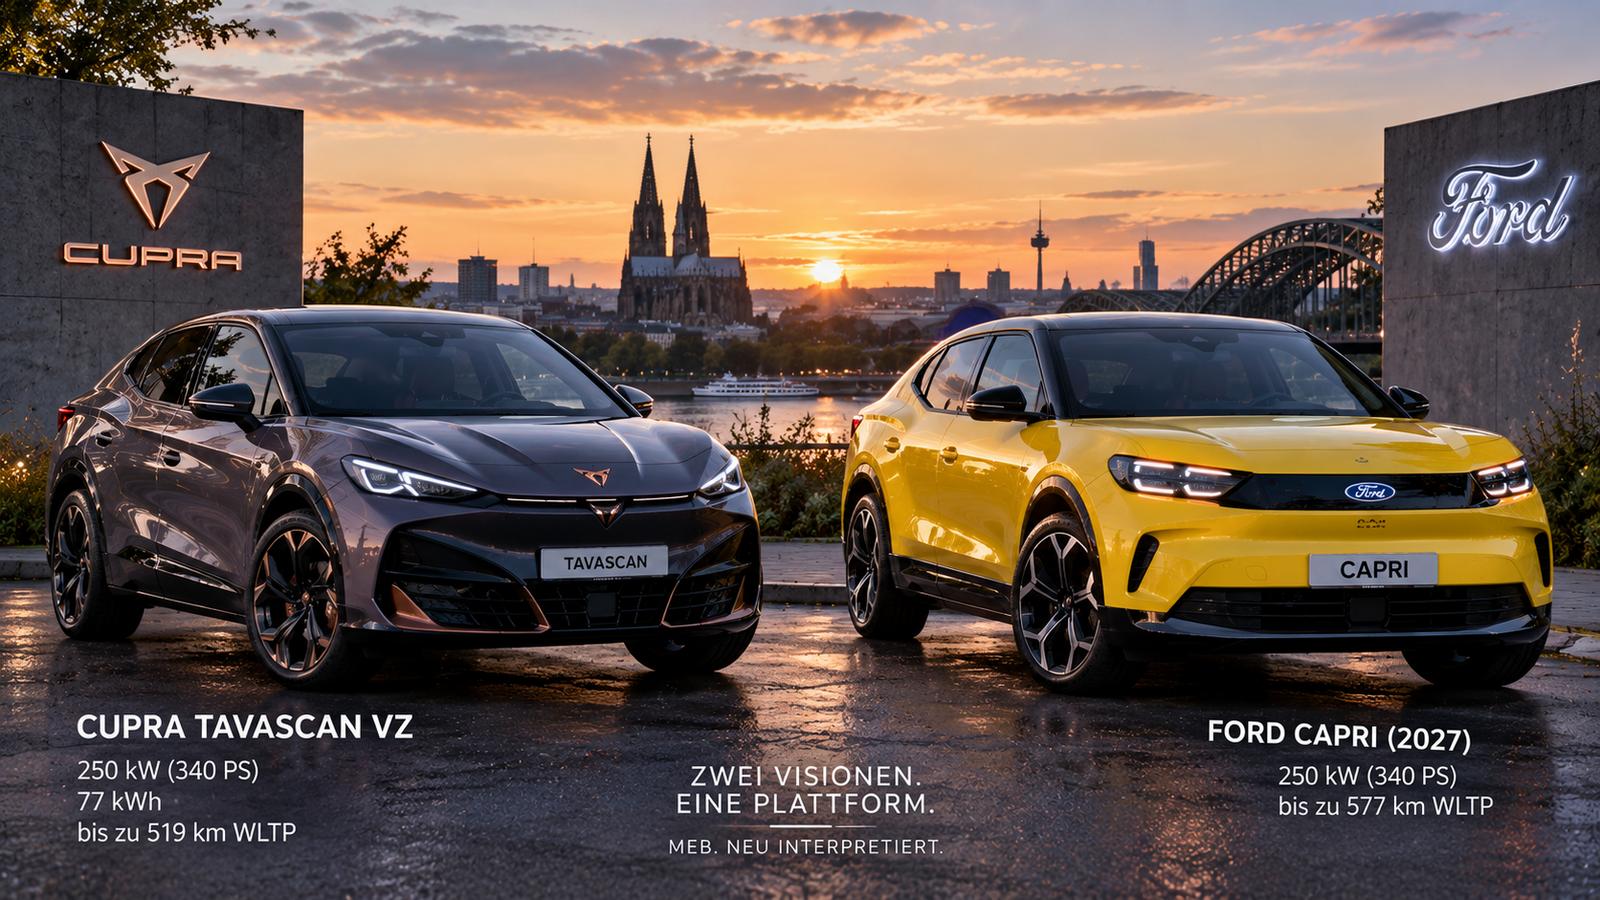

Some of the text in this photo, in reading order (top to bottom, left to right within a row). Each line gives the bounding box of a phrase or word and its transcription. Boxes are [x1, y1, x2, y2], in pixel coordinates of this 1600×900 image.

[1427, 159, 1573, 252] Ford
[63, 241, 242, 271] CUPRA
[1355, 484, 1386, 498] Ford
[564, 554, 648, 570] TAVASCAN
[1340, 559, 1409, 579] CAPRI
